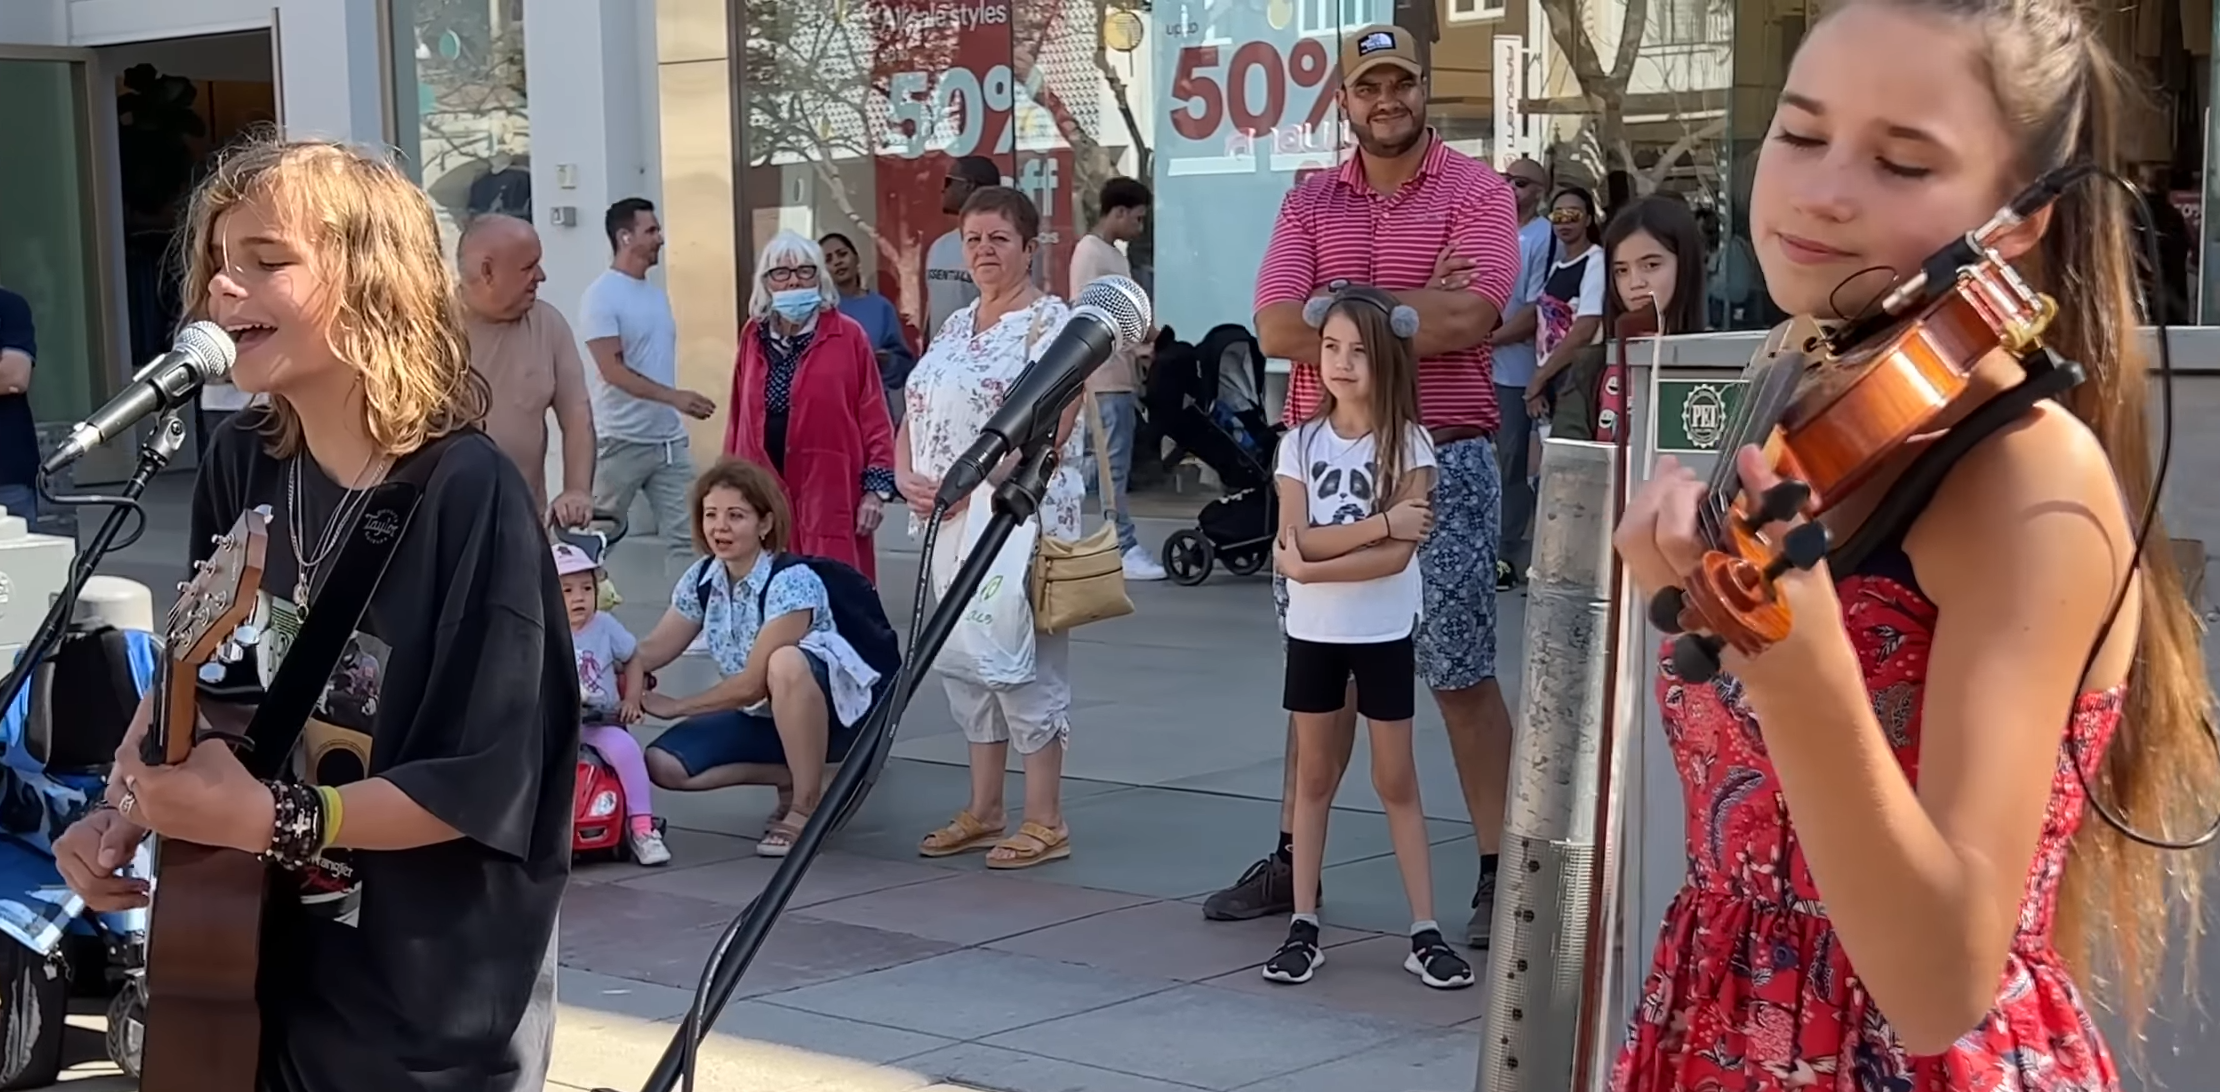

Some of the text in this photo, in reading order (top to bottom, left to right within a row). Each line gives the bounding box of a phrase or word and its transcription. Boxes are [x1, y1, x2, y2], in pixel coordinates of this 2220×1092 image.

[950, 0, 1008, 31] styles
[889, 64, 1049, 159] 50%
[1169, 37, 1344, 141] 50%
[999, 157, 1059, 217] ff
[1692, 404, 1717, 428] PEI
[363, 513, 399, 537] Taylor
